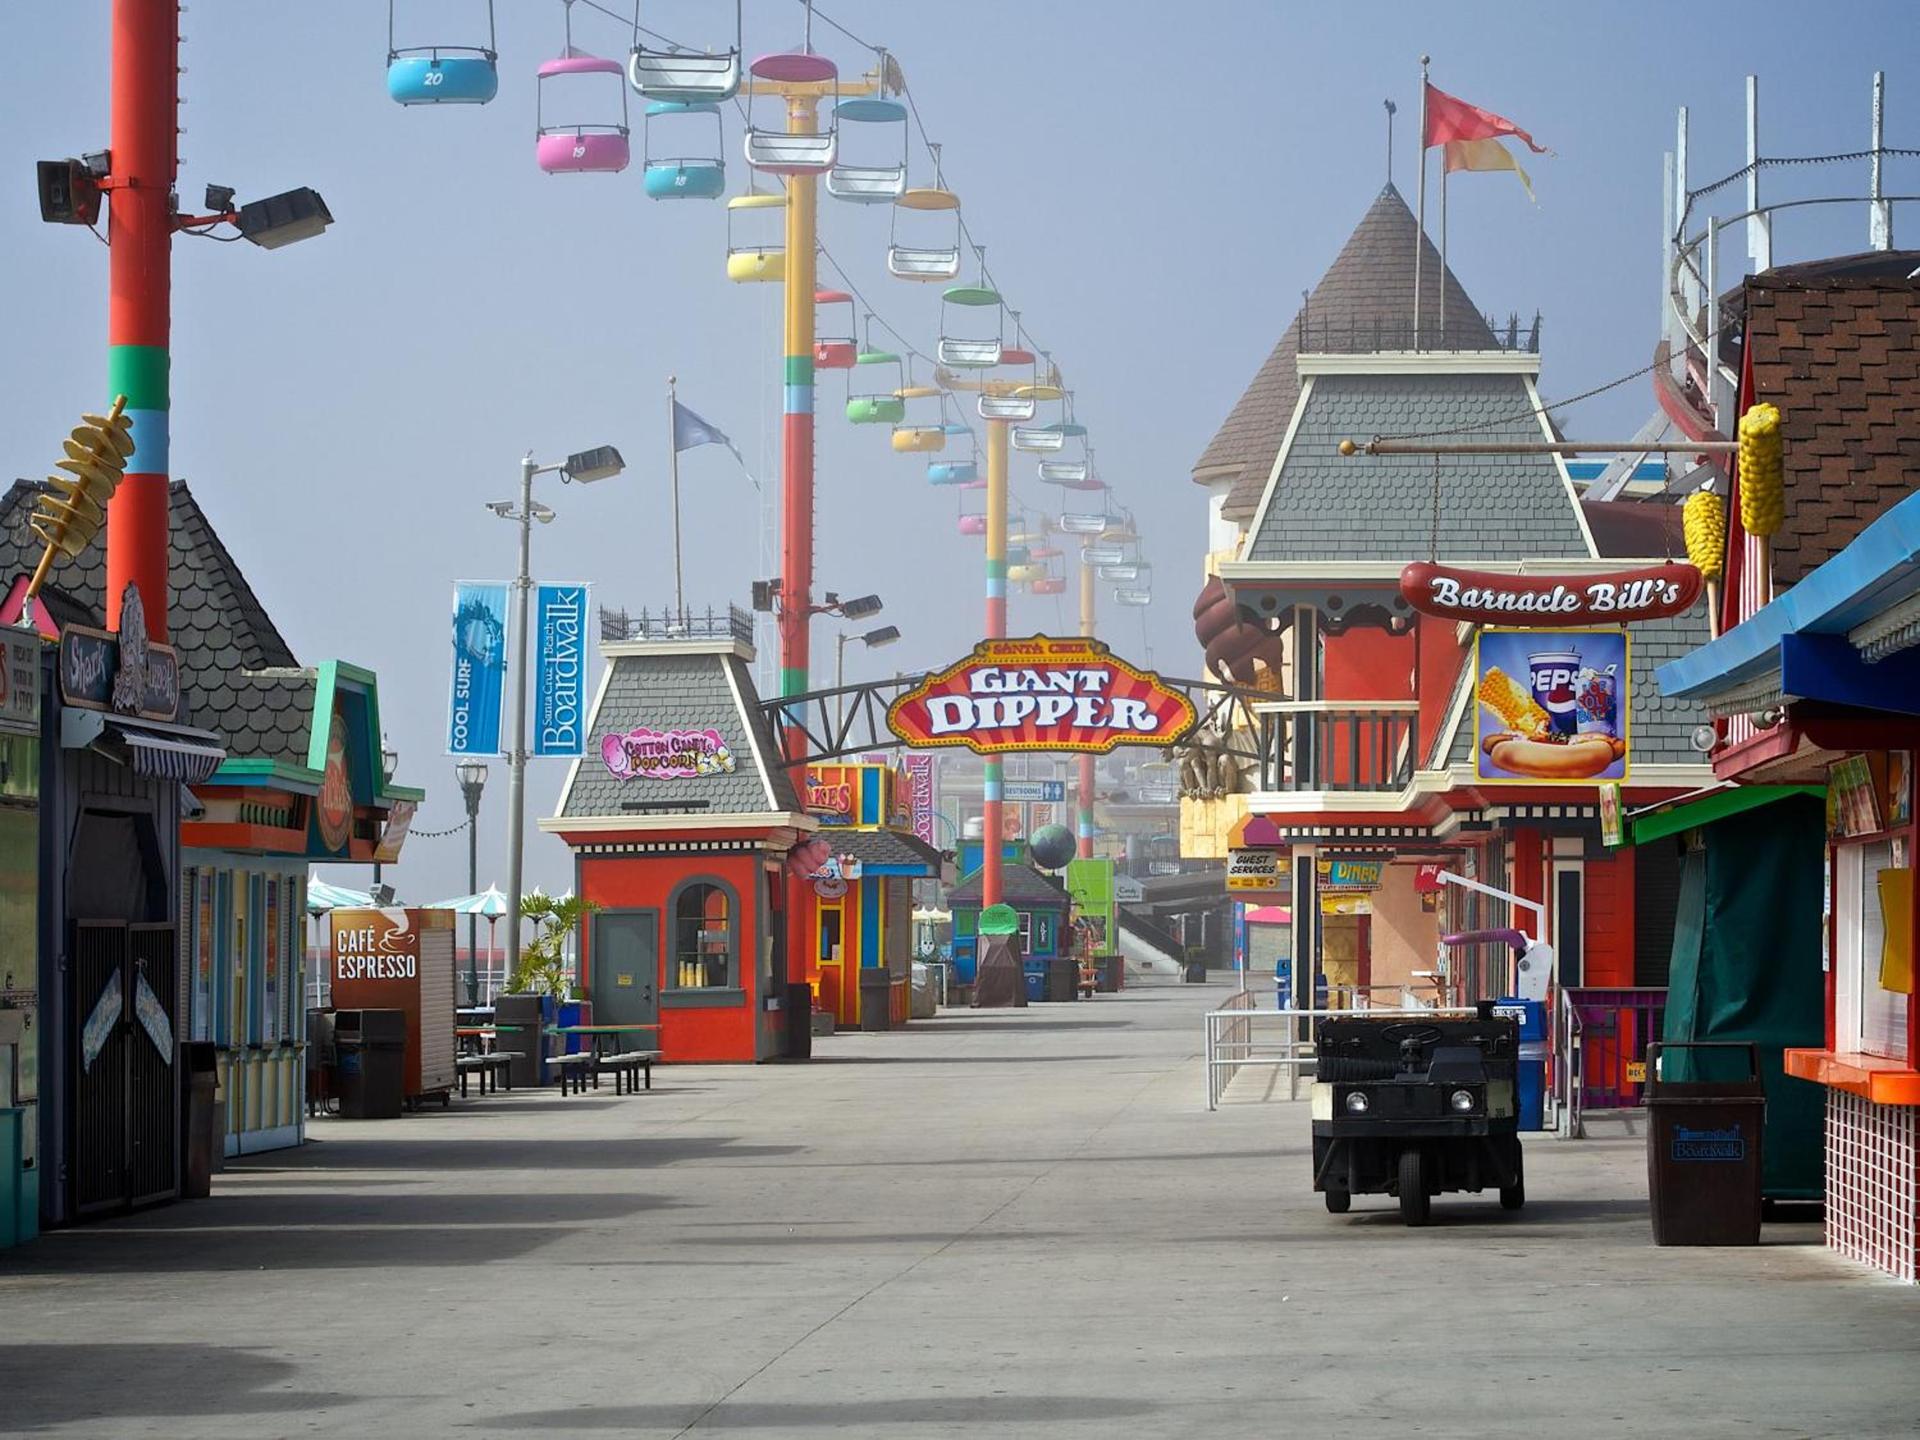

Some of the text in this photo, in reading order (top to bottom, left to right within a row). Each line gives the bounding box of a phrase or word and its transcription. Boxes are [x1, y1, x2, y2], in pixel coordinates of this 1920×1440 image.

[423, 72, 443, 87] 20
[572, 145, 586, 158] 19
[674, 175, 687, 187] 18
[1430, 577, 1681, 613] Barnacle Bill's
[542, 589, 579, 754] Boardwalk
[542, 621, 554, 727] Santa Cruz Beach
[969, 667, 1110, 694] GIANT
[453, 657, 472, 751] COOL SURF
[926, 694, 1159, 735] DIPPER
[625, 740, 670, 756] COTTON
[630, 753, 699, 771] POPCORN
[1229, 865, 1276, 875] SERVICES
[1236, 855, 1270, 865] GUEST
[1338, 862, 1379, 882] DINER
[337, 924, 376, 953] CAFÉ
[337, 954, 416, 979] ESPRESSO
[1676, 1142, 1741, 1158] Boardwalk
